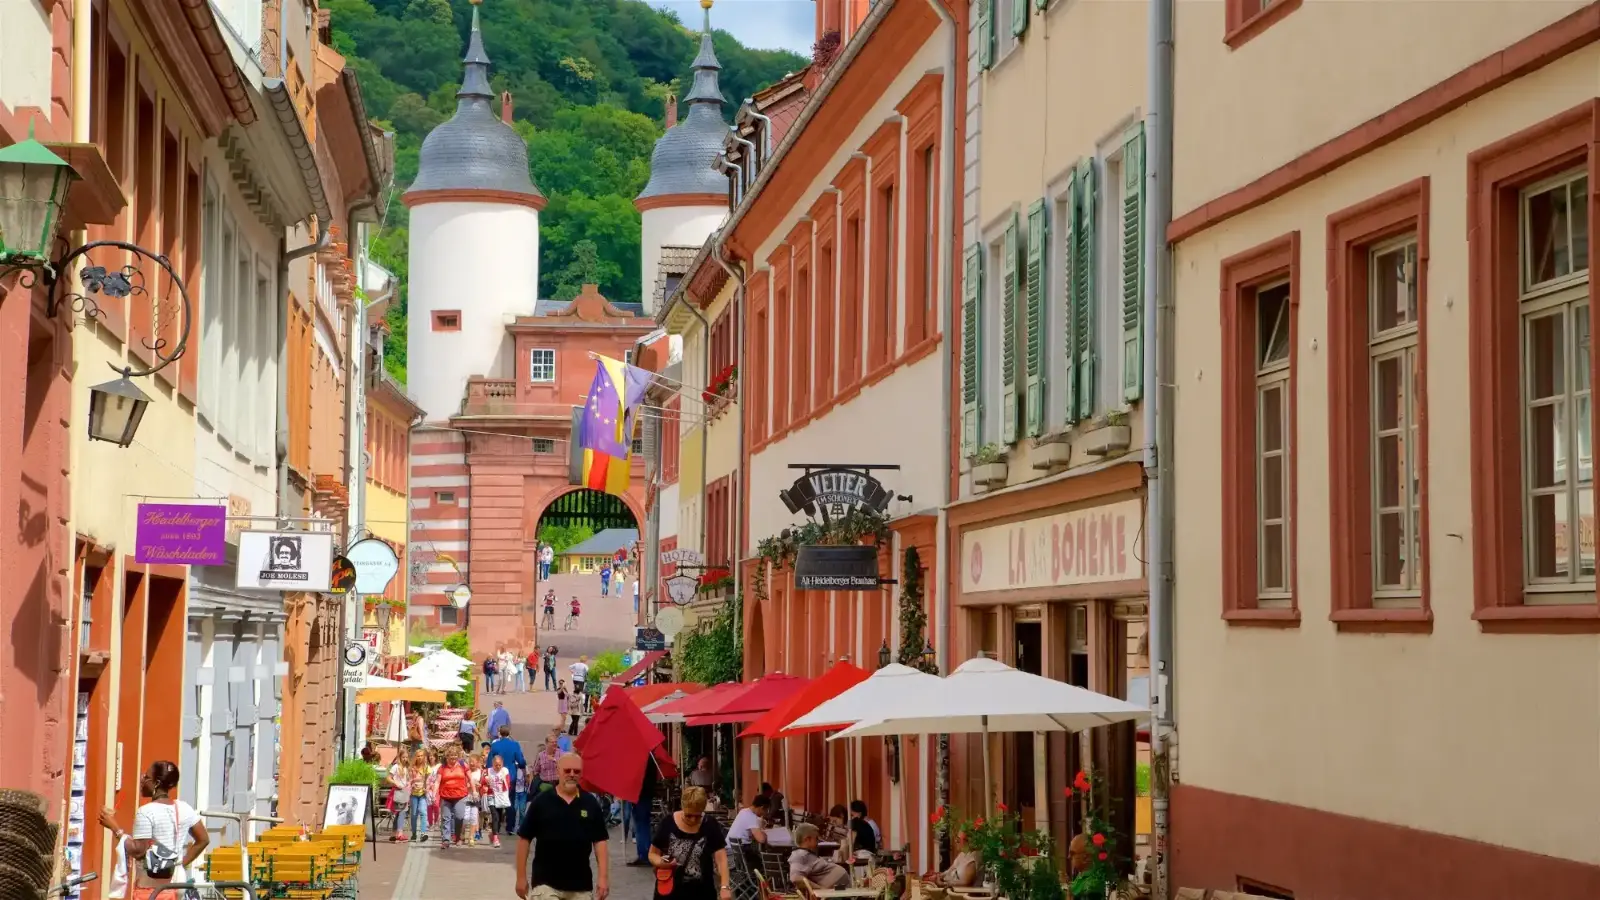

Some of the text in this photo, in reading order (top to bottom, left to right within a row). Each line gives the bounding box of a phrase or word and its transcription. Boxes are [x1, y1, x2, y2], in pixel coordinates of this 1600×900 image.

[808, 472, 867, 497] VETTER
[144, 510, 220, 531] Heidelberger
[142, 545, 217, 560] Wäscheladen
[663, 550, 700, 564] HOTEL
[1008, 527, 1026, 585] LA
[260, 572, 307, 580] JOE MOLESE
